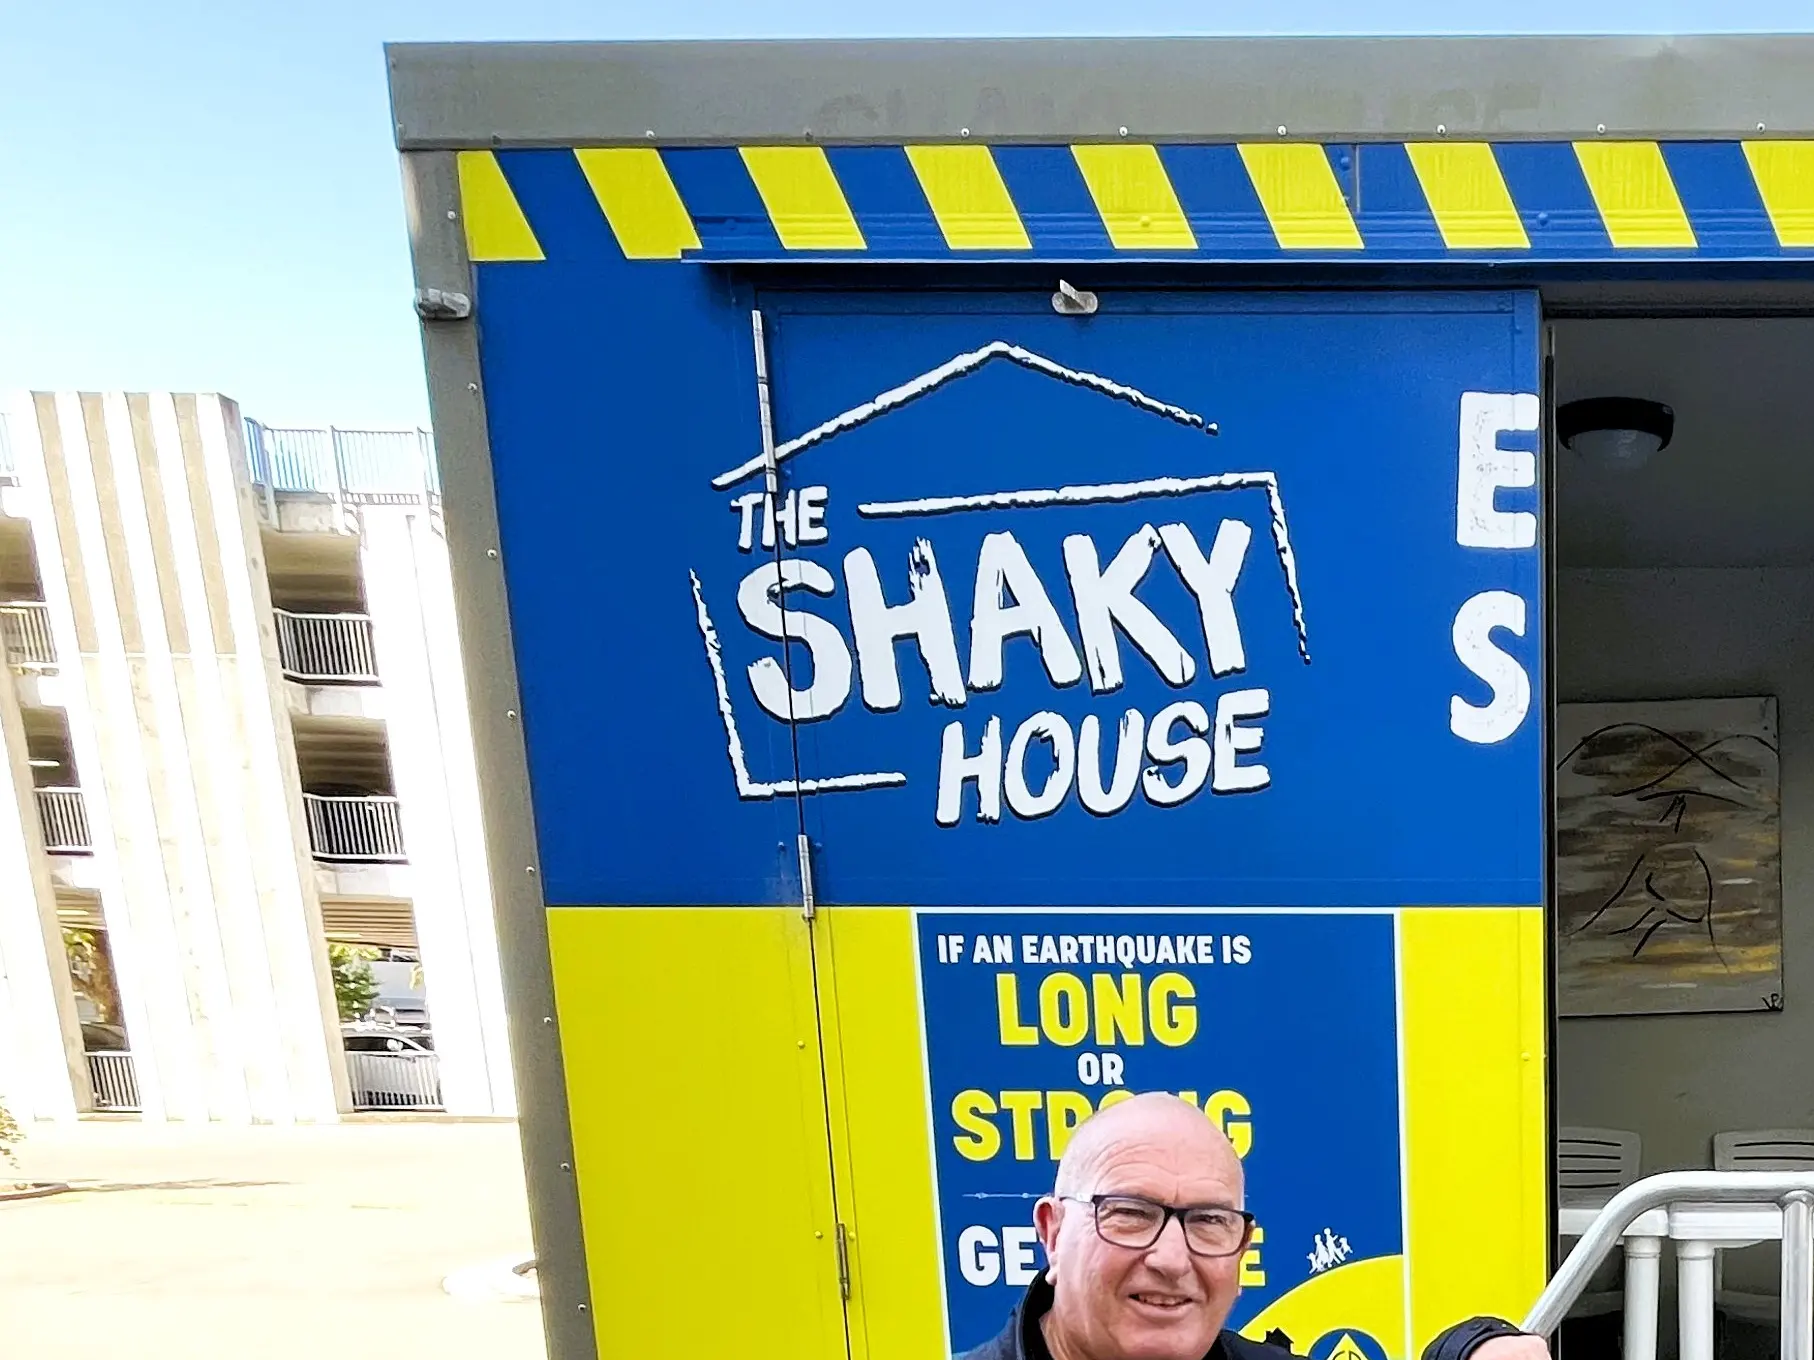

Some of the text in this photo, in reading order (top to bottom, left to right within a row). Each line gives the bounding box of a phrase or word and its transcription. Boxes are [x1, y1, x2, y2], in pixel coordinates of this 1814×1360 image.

[731, 485, 829, 552] THE
[735, 518, 1254, 724] SHAKY
[935, 687, 1272, 827] HOUSE
[937, 934, 1252, 969] IF AN EARTHQUAKE IS
[996, 973, 1199, 1049] LONG
[1077, 1051, 1125, 1087] OR
[951, 1089, 1253, 1163] STRG
[957, 1224, 1040, 1287] GE
